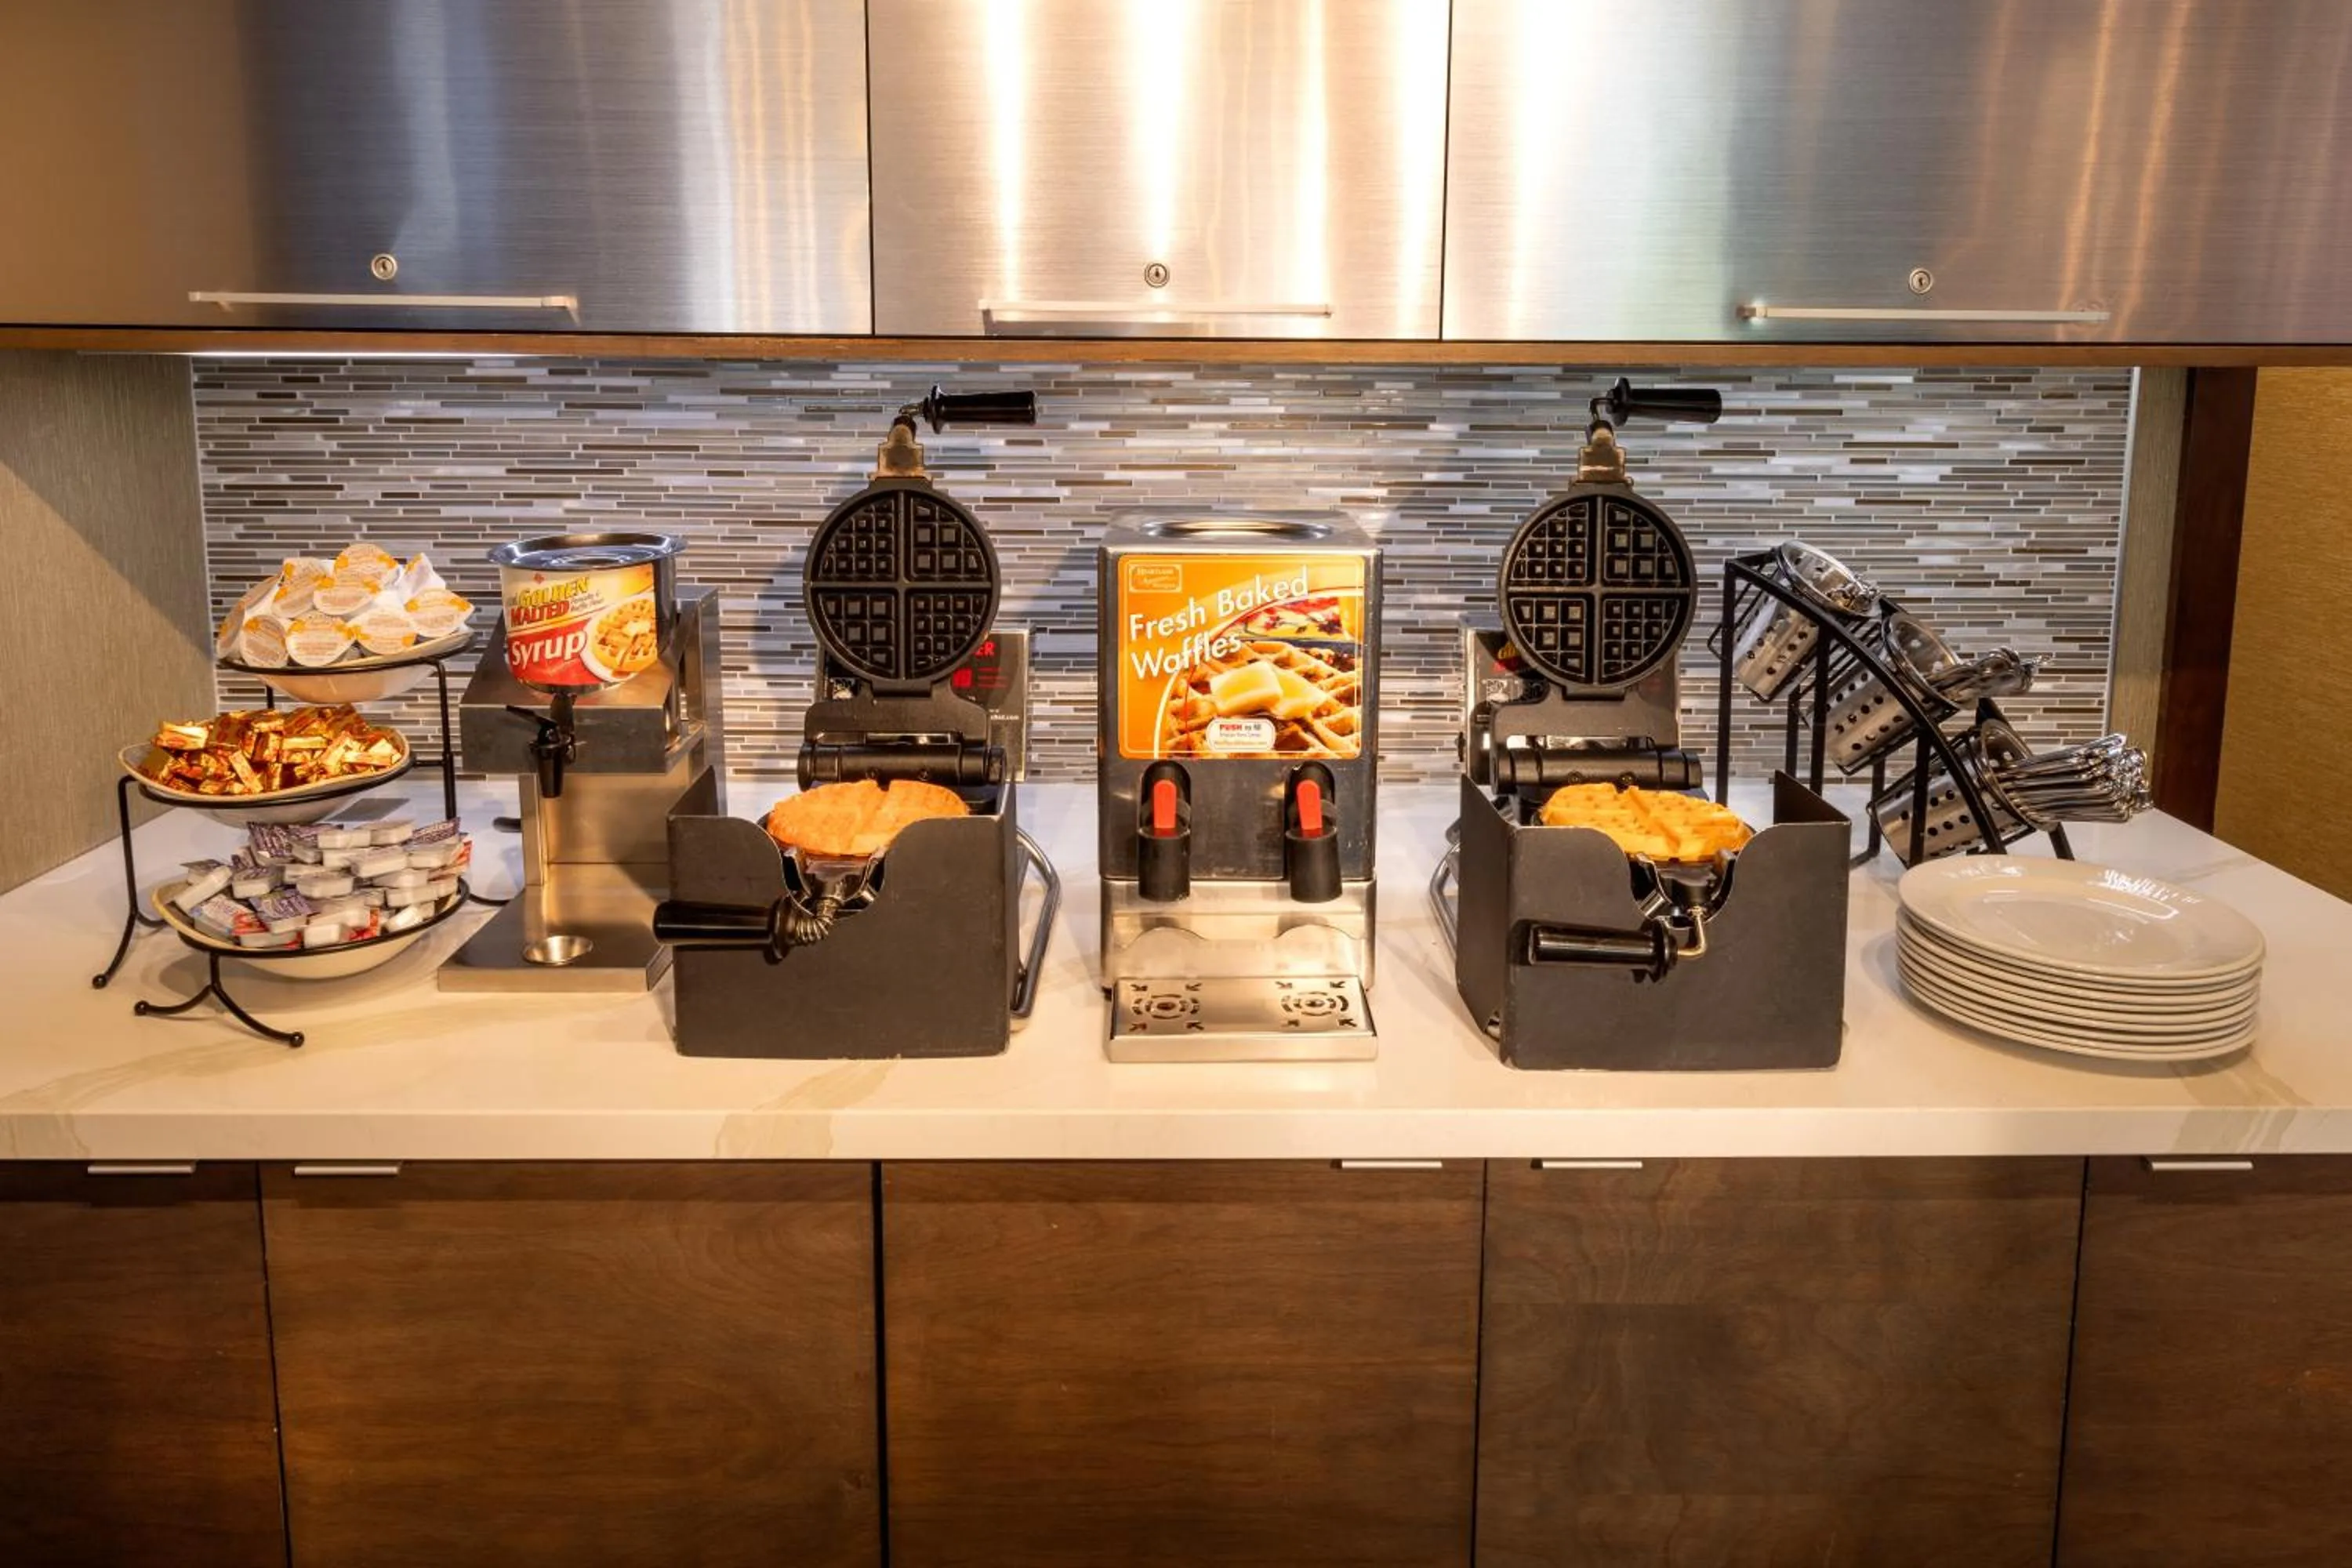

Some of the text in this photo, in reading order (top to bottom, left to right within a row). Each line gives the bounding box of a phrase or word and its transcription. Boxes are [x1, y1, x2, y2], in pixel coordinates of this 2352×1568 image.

[511, 601, 569, 626] MALTED
[1129, 564, 1309, 641] Fresh Baked
[1131, 630, 1242, 681] Waffles
